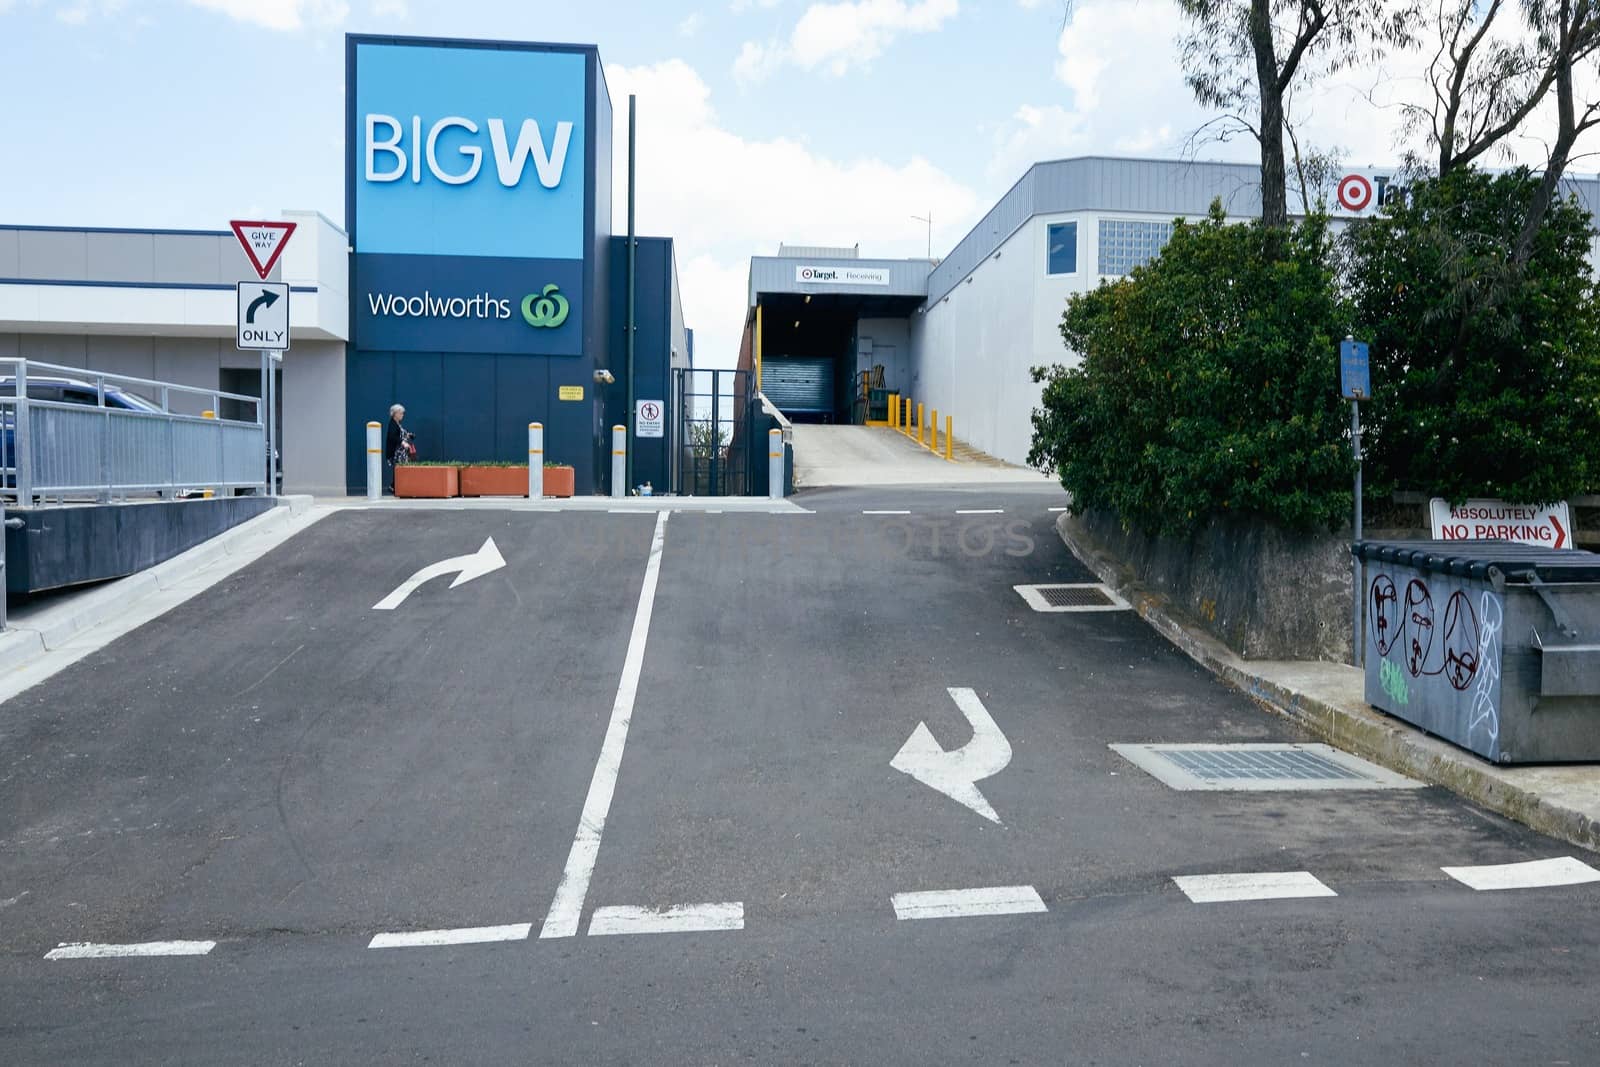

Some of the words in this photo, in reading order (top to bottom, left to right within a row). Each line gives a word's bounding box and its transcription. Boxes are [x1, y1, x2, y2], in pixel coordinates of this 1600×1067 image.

[251, 231, 276, 241] GIVE
[255, 241, 272, 249] WAY
[846, 271, 882, 281] Receiving
[368, 290, 511, 319] Woolworths
[242, 330, 284, 342] ONLY
[1451, 507, 1537, 520] ABSOLUTELY
[1441, 524, 1469, 540] NO
[1475, 525, 1552, 541] PARKING
